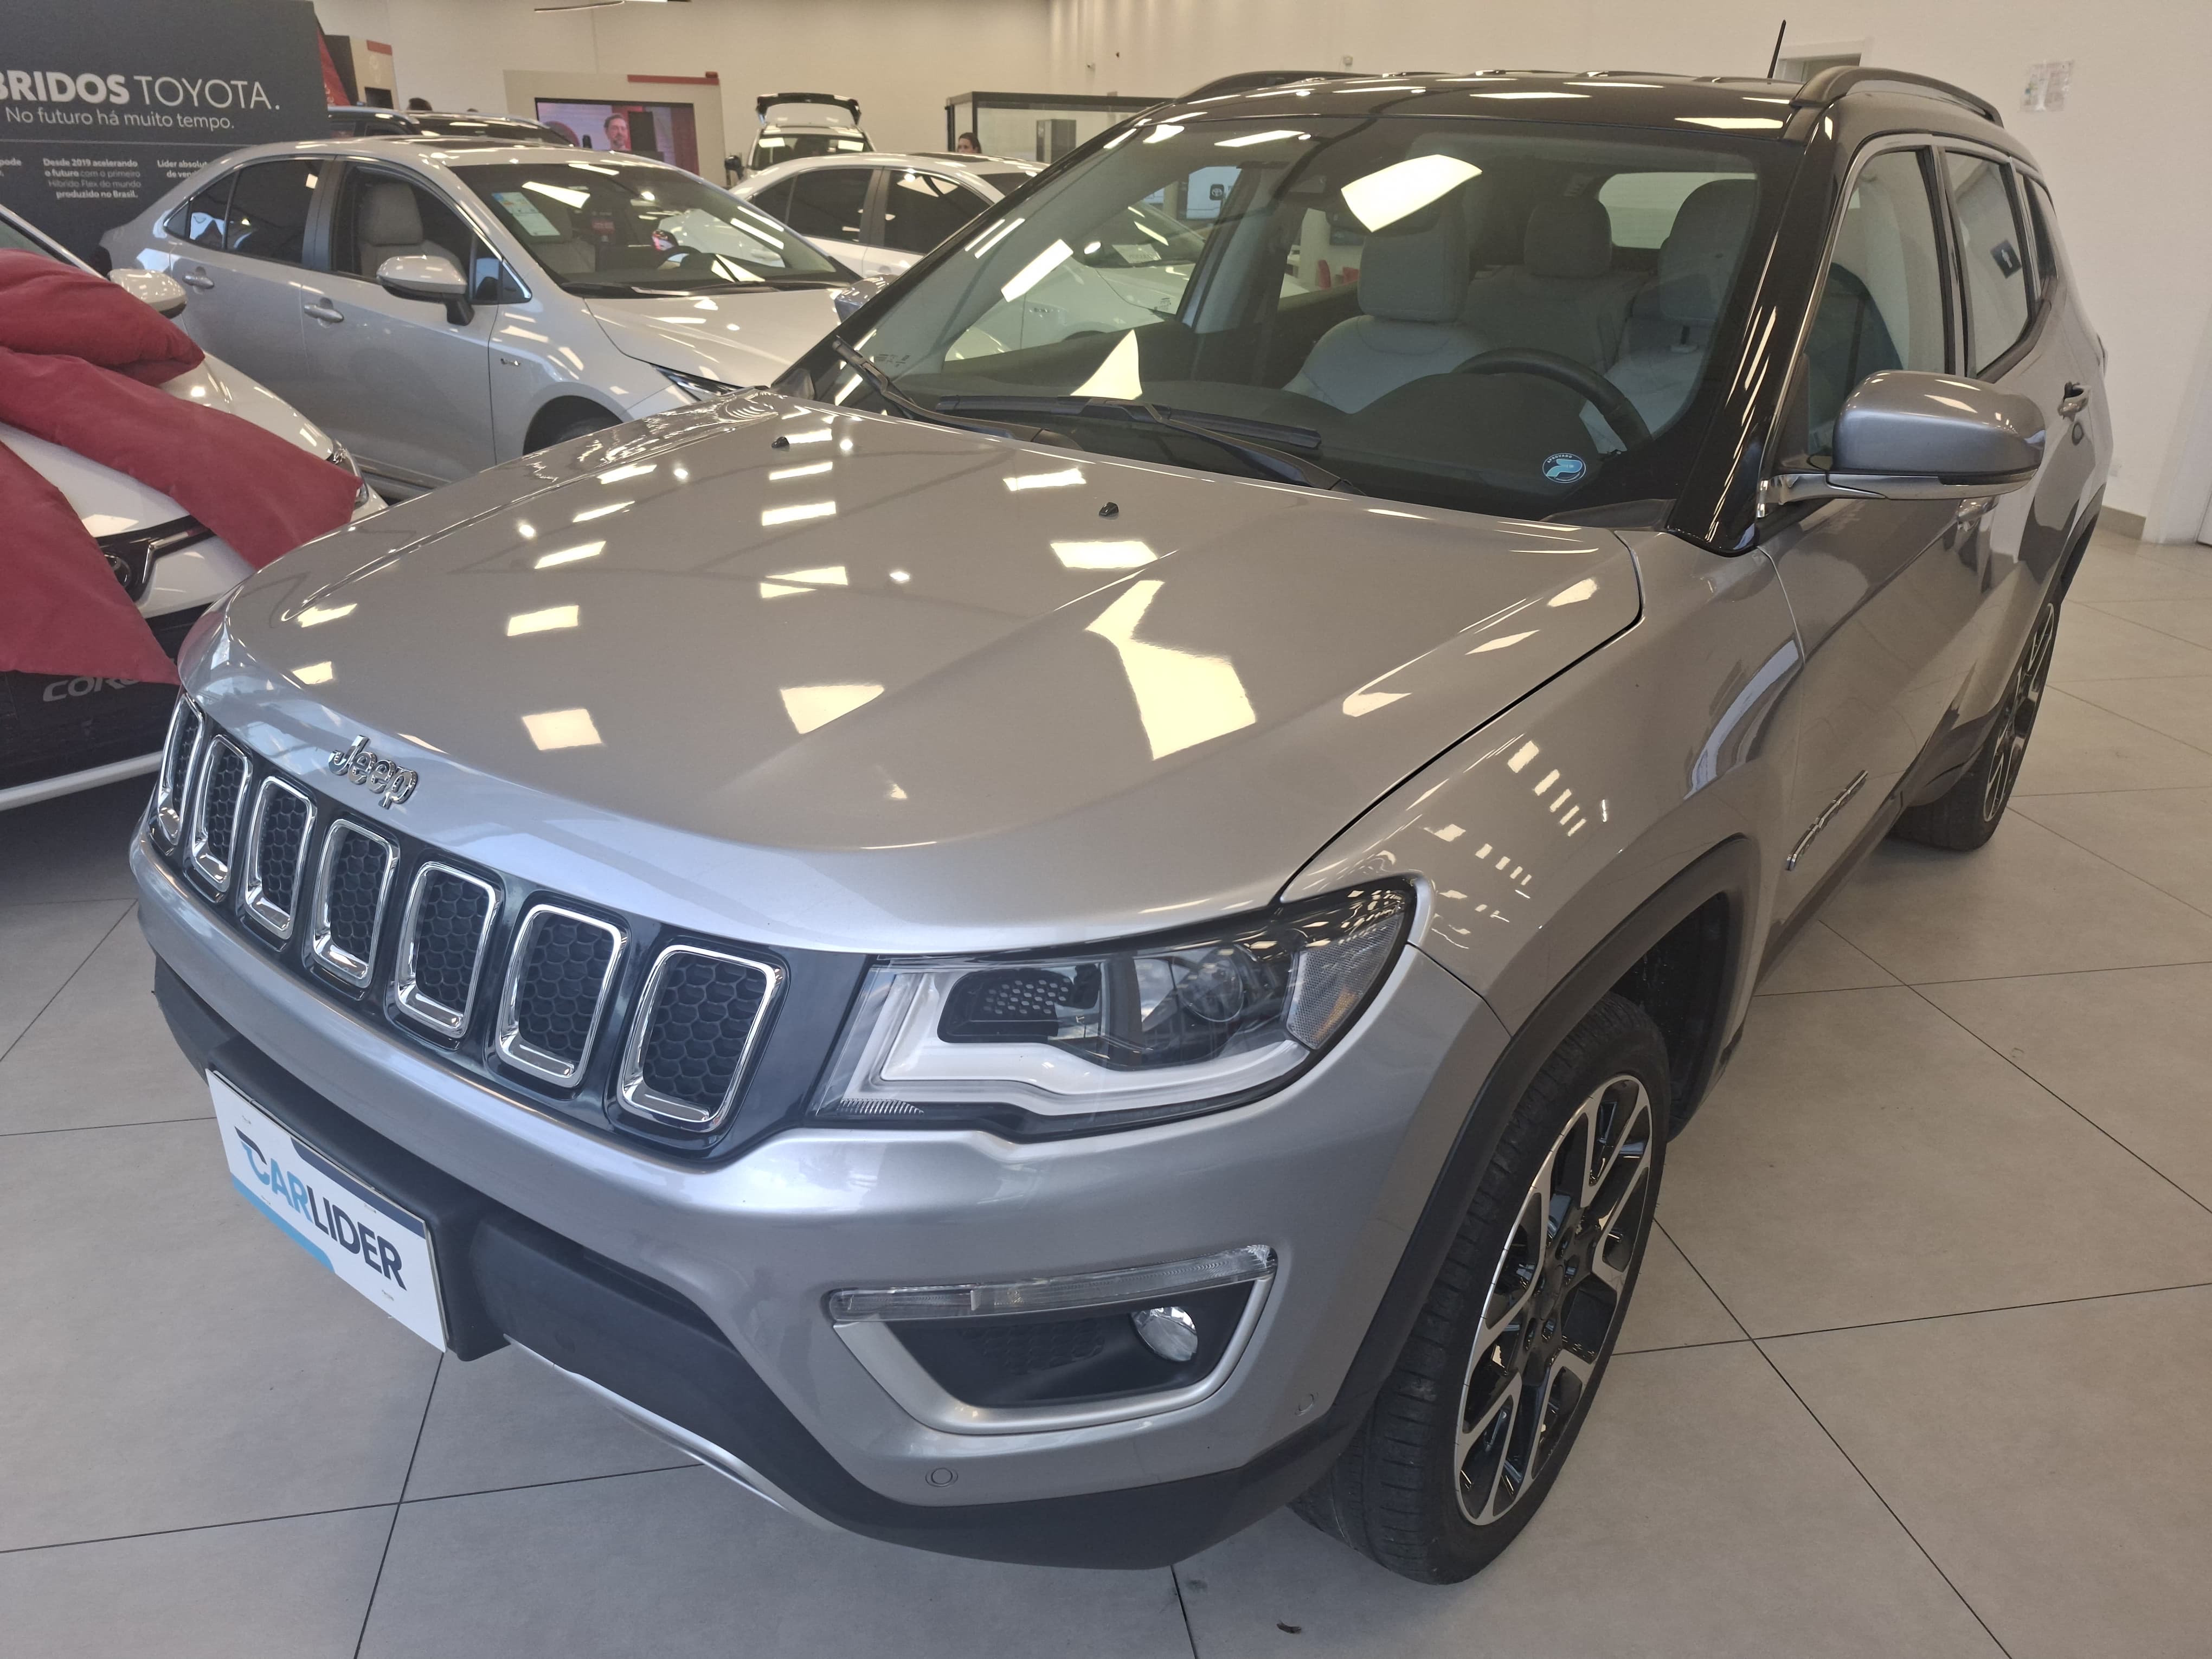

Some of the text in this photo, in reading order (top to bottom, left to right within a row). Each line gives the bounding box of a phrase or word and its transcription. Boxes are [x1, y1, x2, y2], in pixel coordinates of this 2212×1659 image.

[133, 75, 280, 110] TOYOTA.
[5, 107, 235, 132] No futuro há muito tempo.
[43, 158, 138, 167] Desde 2019 acelerando
[52, 169, 79, 177] futuro
[107, 170, 140, 178] primeiro
[56, 189, 100, 200] produzido
[113, 190, 138, 198] Brasil.
[1547, 454, 1572, 464] APROVADO
[328, 735, 418, 810] Jeep
[234, 1126, 407, 1291] CARLIDER
